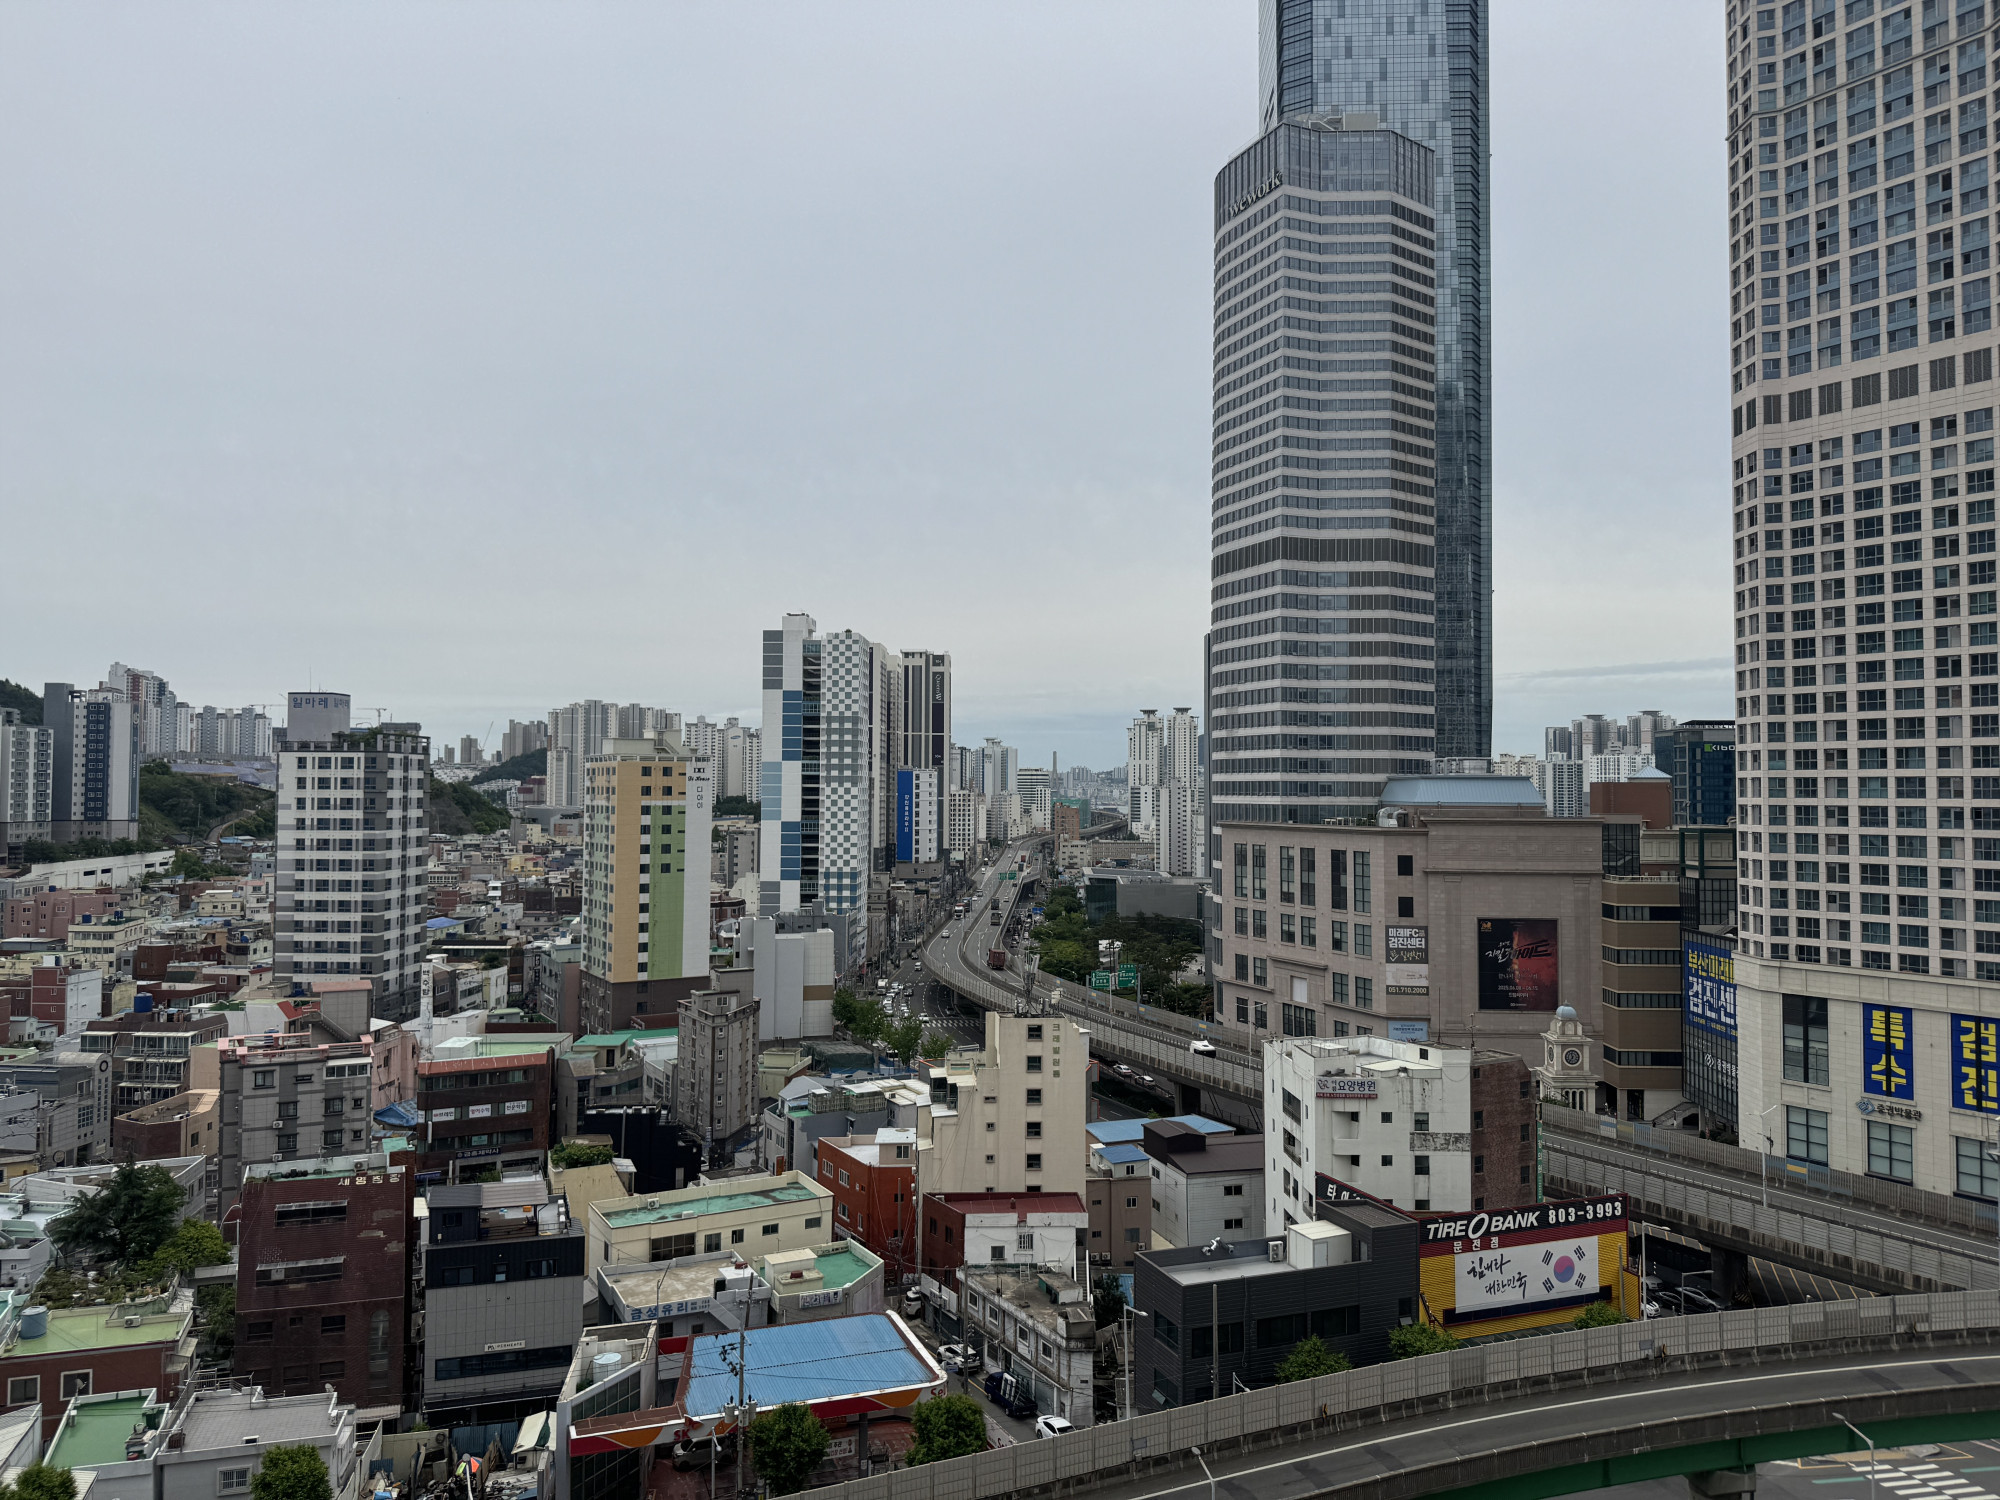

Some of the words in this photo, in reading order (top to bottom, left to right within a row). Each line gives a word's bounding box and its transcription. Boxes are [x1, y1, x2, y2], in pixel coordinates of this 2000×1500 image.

[1229, 171, 1283, 217] wework
[293, 697, 328, 709] 일마레
[1388, 937, 1426, 949] 검진센터
[1688, 976, 1738, 1026] 검진센
[1870, 1009, 1907, 1093] 특수
[1960, 1020, 1999, 1110] 검진
[1338, 1080, 1376, 1092] 요양병원
[1876, 1103, 1922, 1121] 증권박물관
[1548, 1201, 1623, 1224] 803-3993
[1466, 1253, 1512, 1280] 힘내라
[1484, 1271, 1528, 1300] 대한민국
[631, 1302, 688, 1321] 금성유리
[673, 1428, 691, 1442] SK
